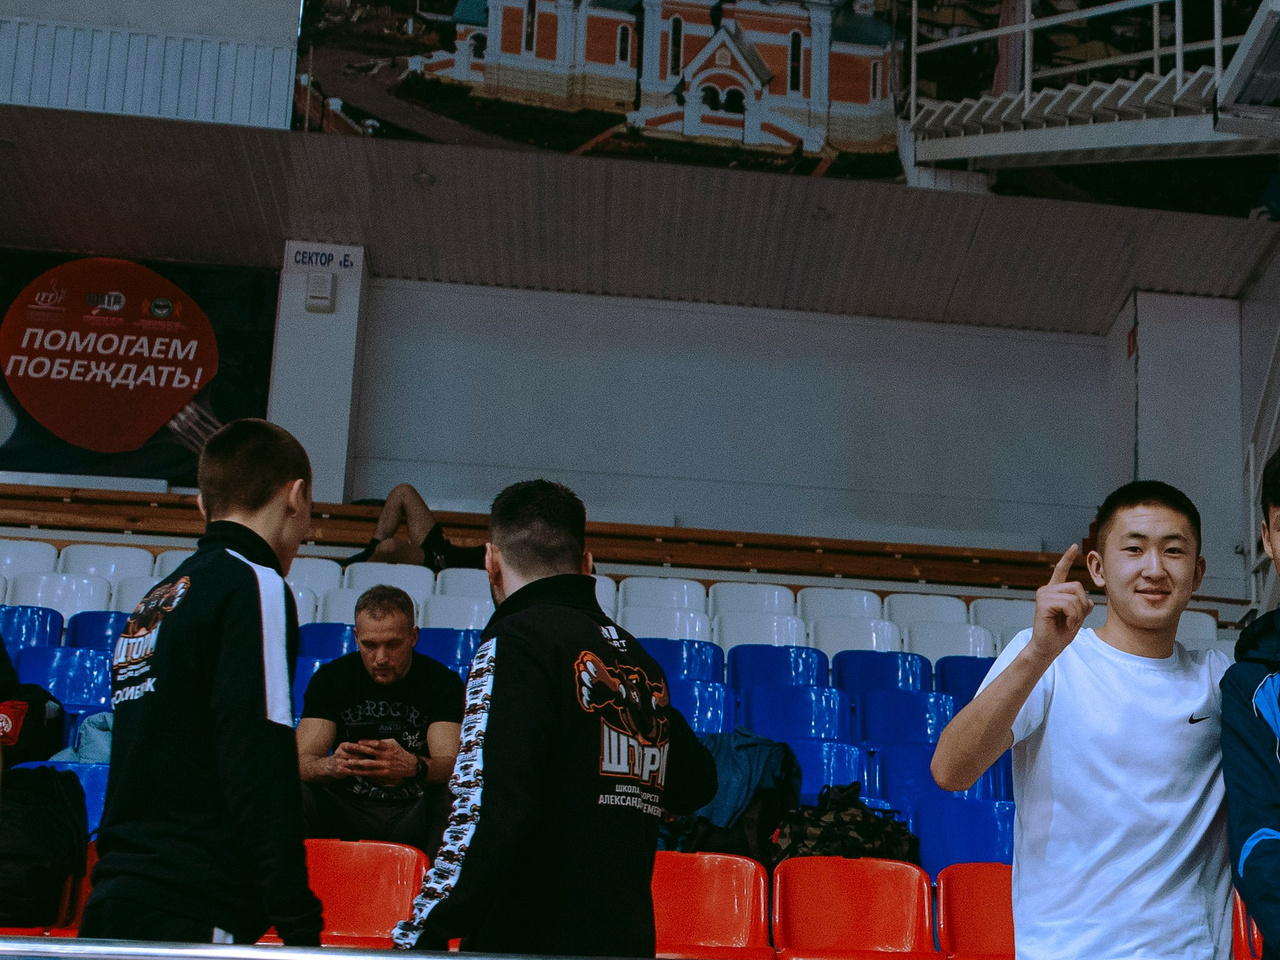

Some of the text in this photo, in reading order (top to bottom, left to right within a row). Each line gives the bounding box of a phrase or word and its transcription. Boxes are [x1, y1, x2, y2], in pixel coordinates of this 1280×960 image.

[294, 250, 334, 267] СЕКТОР
[21, 327, 198, 361] ПОМОГАЕМ
[5, 355, 203, 390] ПОБЕЖДАТЬ!
